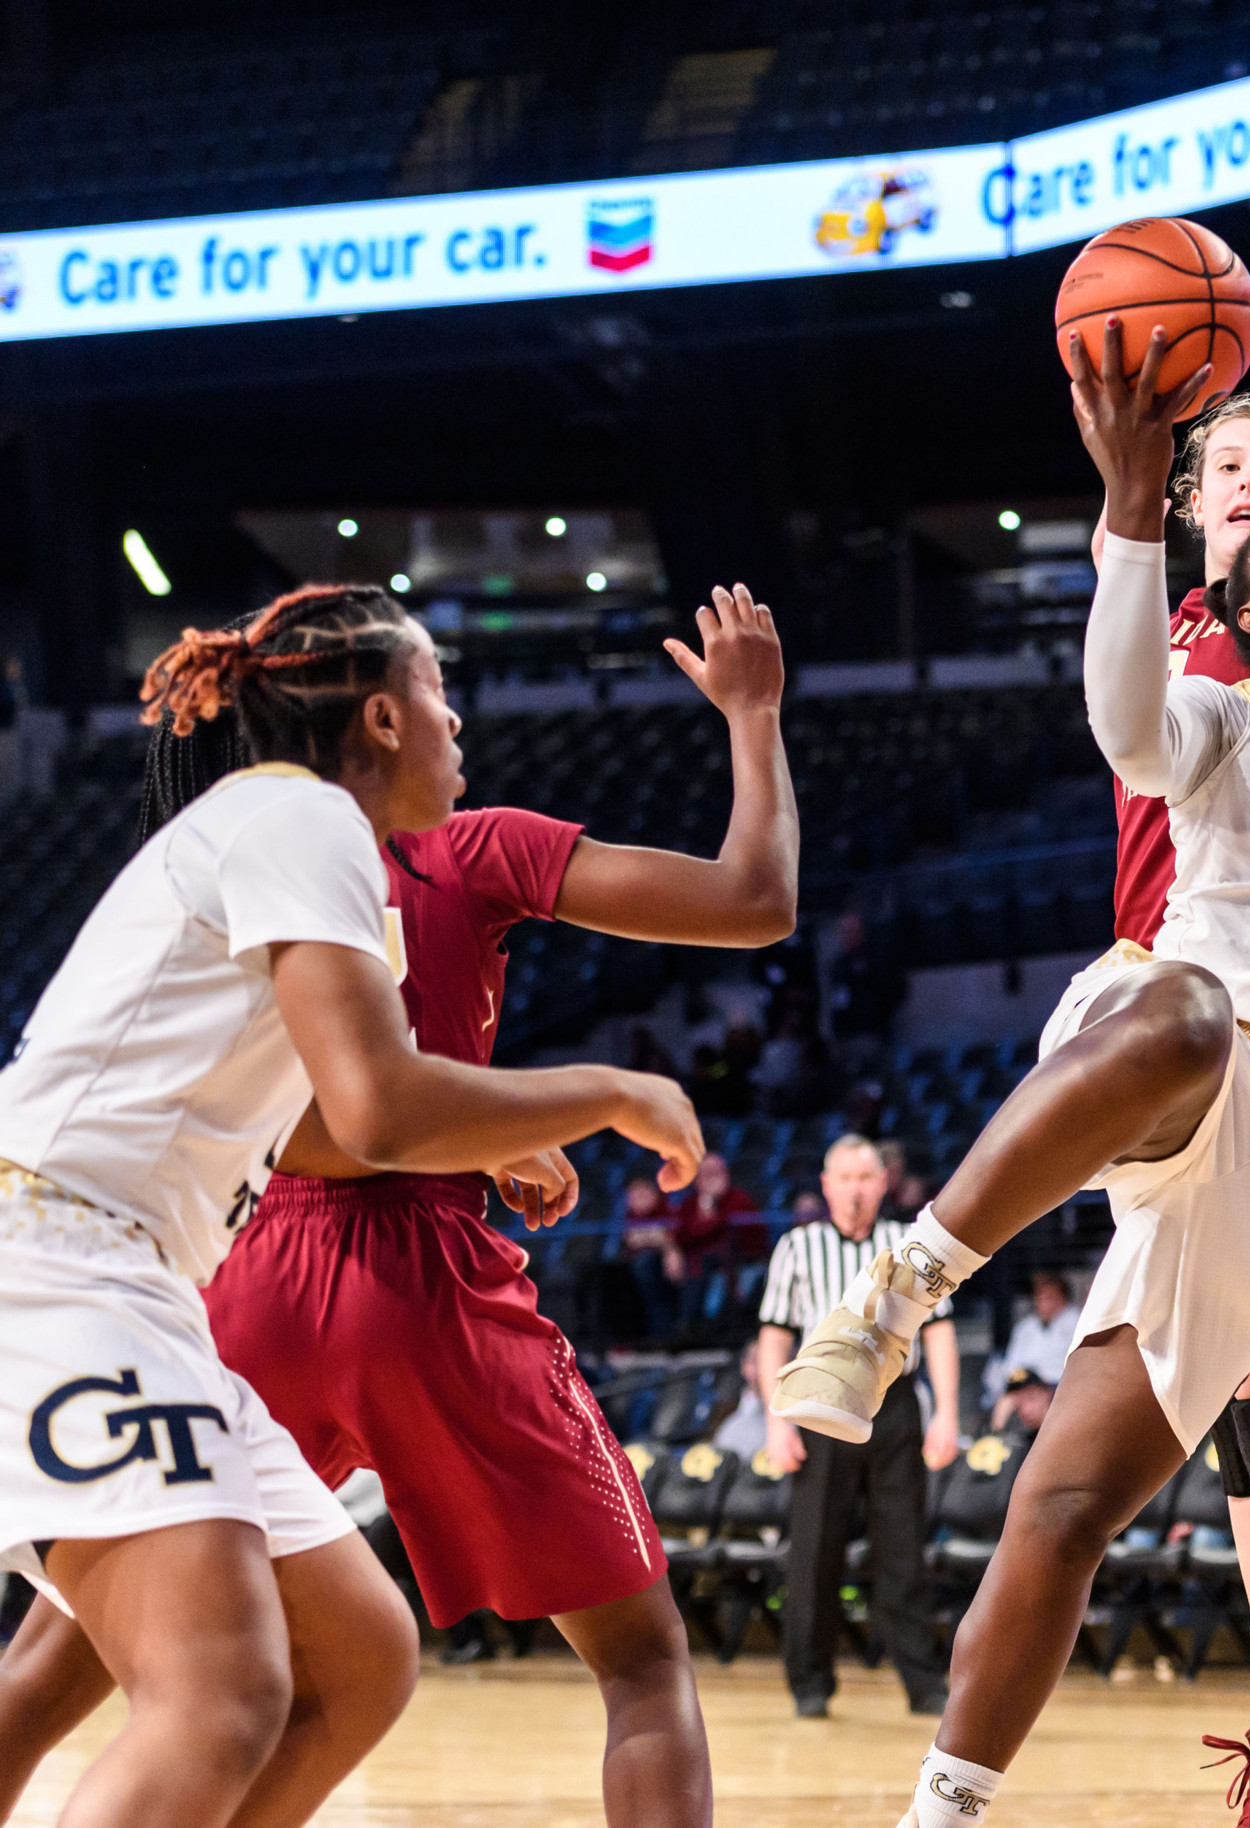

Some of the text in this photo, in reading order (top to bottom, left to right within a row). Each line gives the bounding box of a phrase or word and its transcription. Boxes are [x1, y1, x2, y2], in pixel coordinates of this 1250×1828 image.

[982, 162, 1092, 226] Care
[1113, 134, 1177, 195] for
[60, 224, 547, 304] Care for your car.
[28, 1368, 230, 1486] GT
